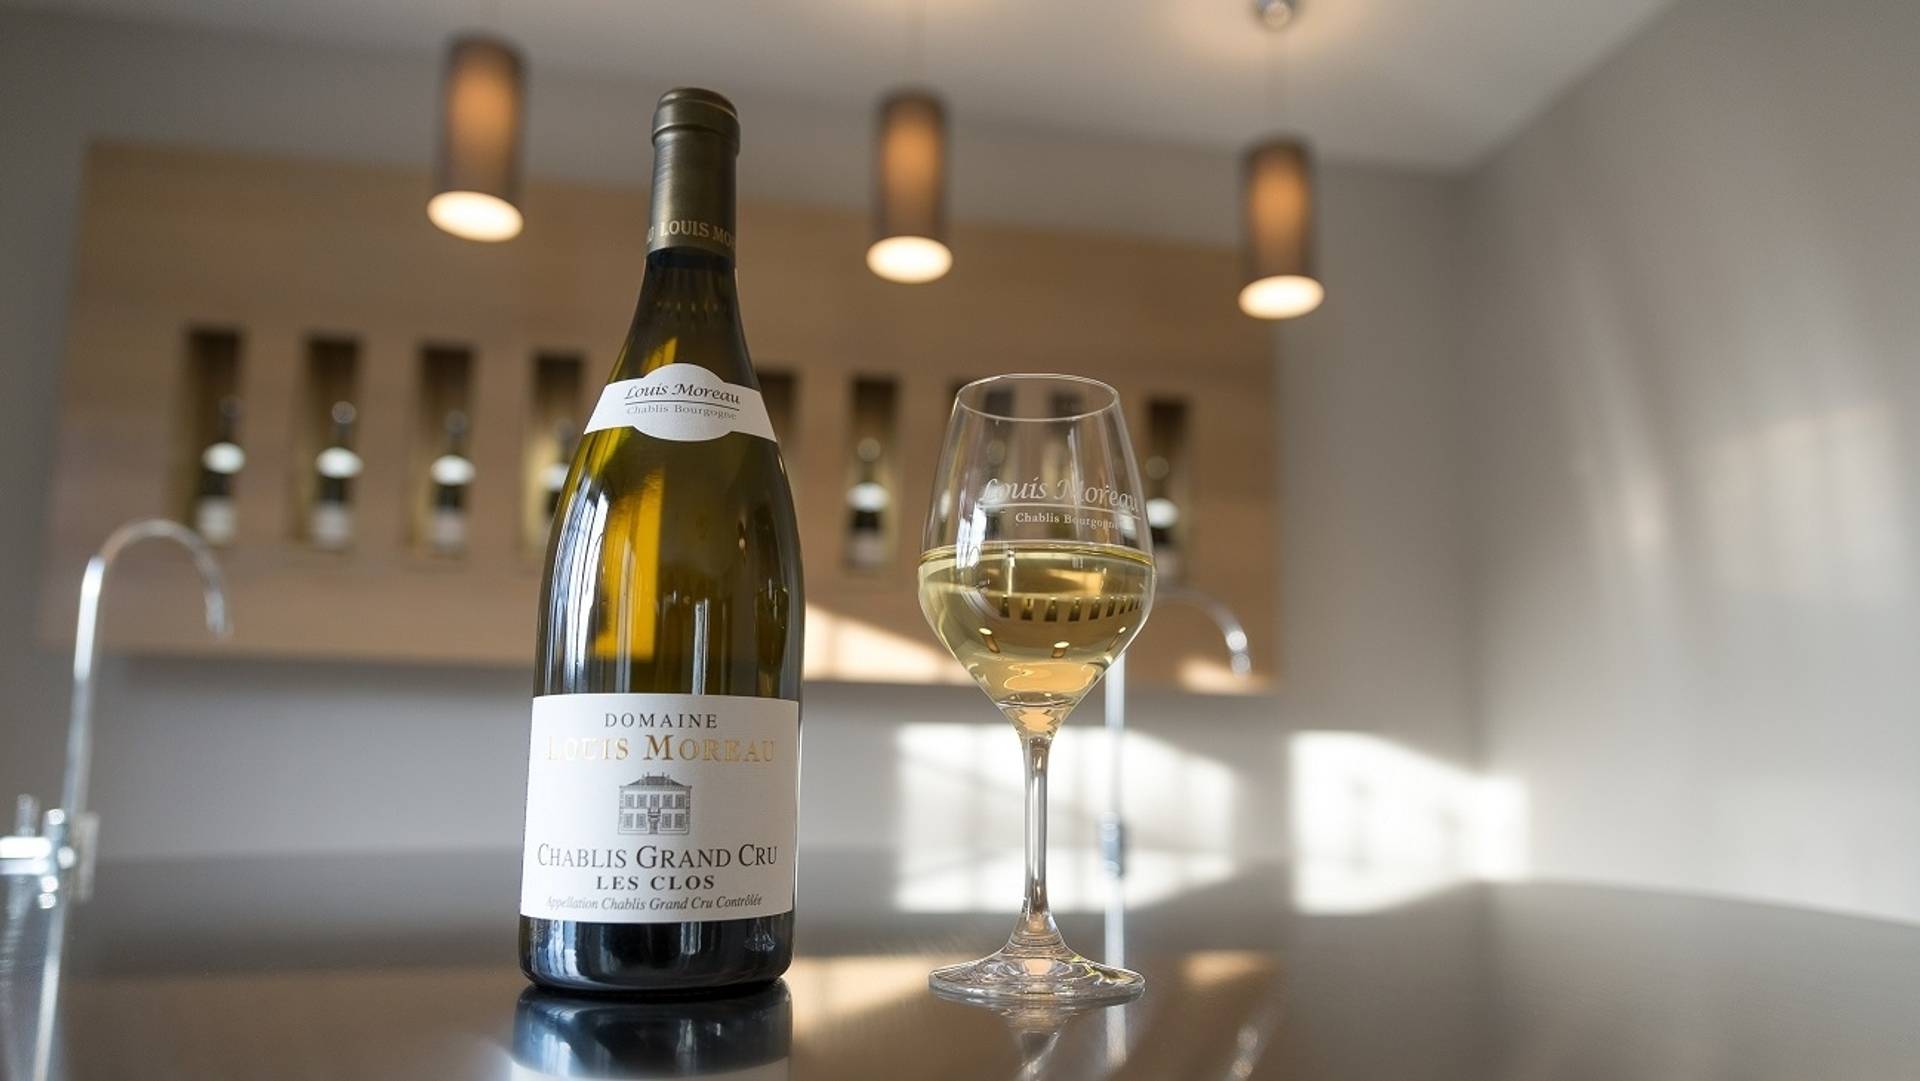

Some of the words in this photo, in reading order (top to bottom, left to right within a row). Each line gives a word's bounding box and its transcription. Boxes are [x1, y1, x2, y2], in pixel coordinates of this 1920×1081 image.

[660, 220, 710, 238] LOUIS
[625, 382, 668, 400] Louis
[671, 383, 741, 404] Moreau
[627, 404, 669, 414] Chablis
[674, 404, 738, 420] Bourgogne
[979, 477, 1049, 501] Louis
[1053, 478, 1139, 513] Moreau
[1015, 512, 1060, 523] Chablis
[604, 713, 718, 728] DOMAINE
[547, 737, 628, 761] LOUIS
[643, 735, 777, 762] MOREAU
[537, 843, 627, 868] CHABLIS
[636, 846, 731, 868] GRAND
[738, 844, 778, 866] CRU
[596, 876, 639, 890] LES
[650, 875, 715, 890] CLOS
[546, 896, 599, 911] Appellation
[601, 897, 645, 910] Chablis
[649, 897, 687, 910] Grand
[691, 897, 713, 908] Cru
